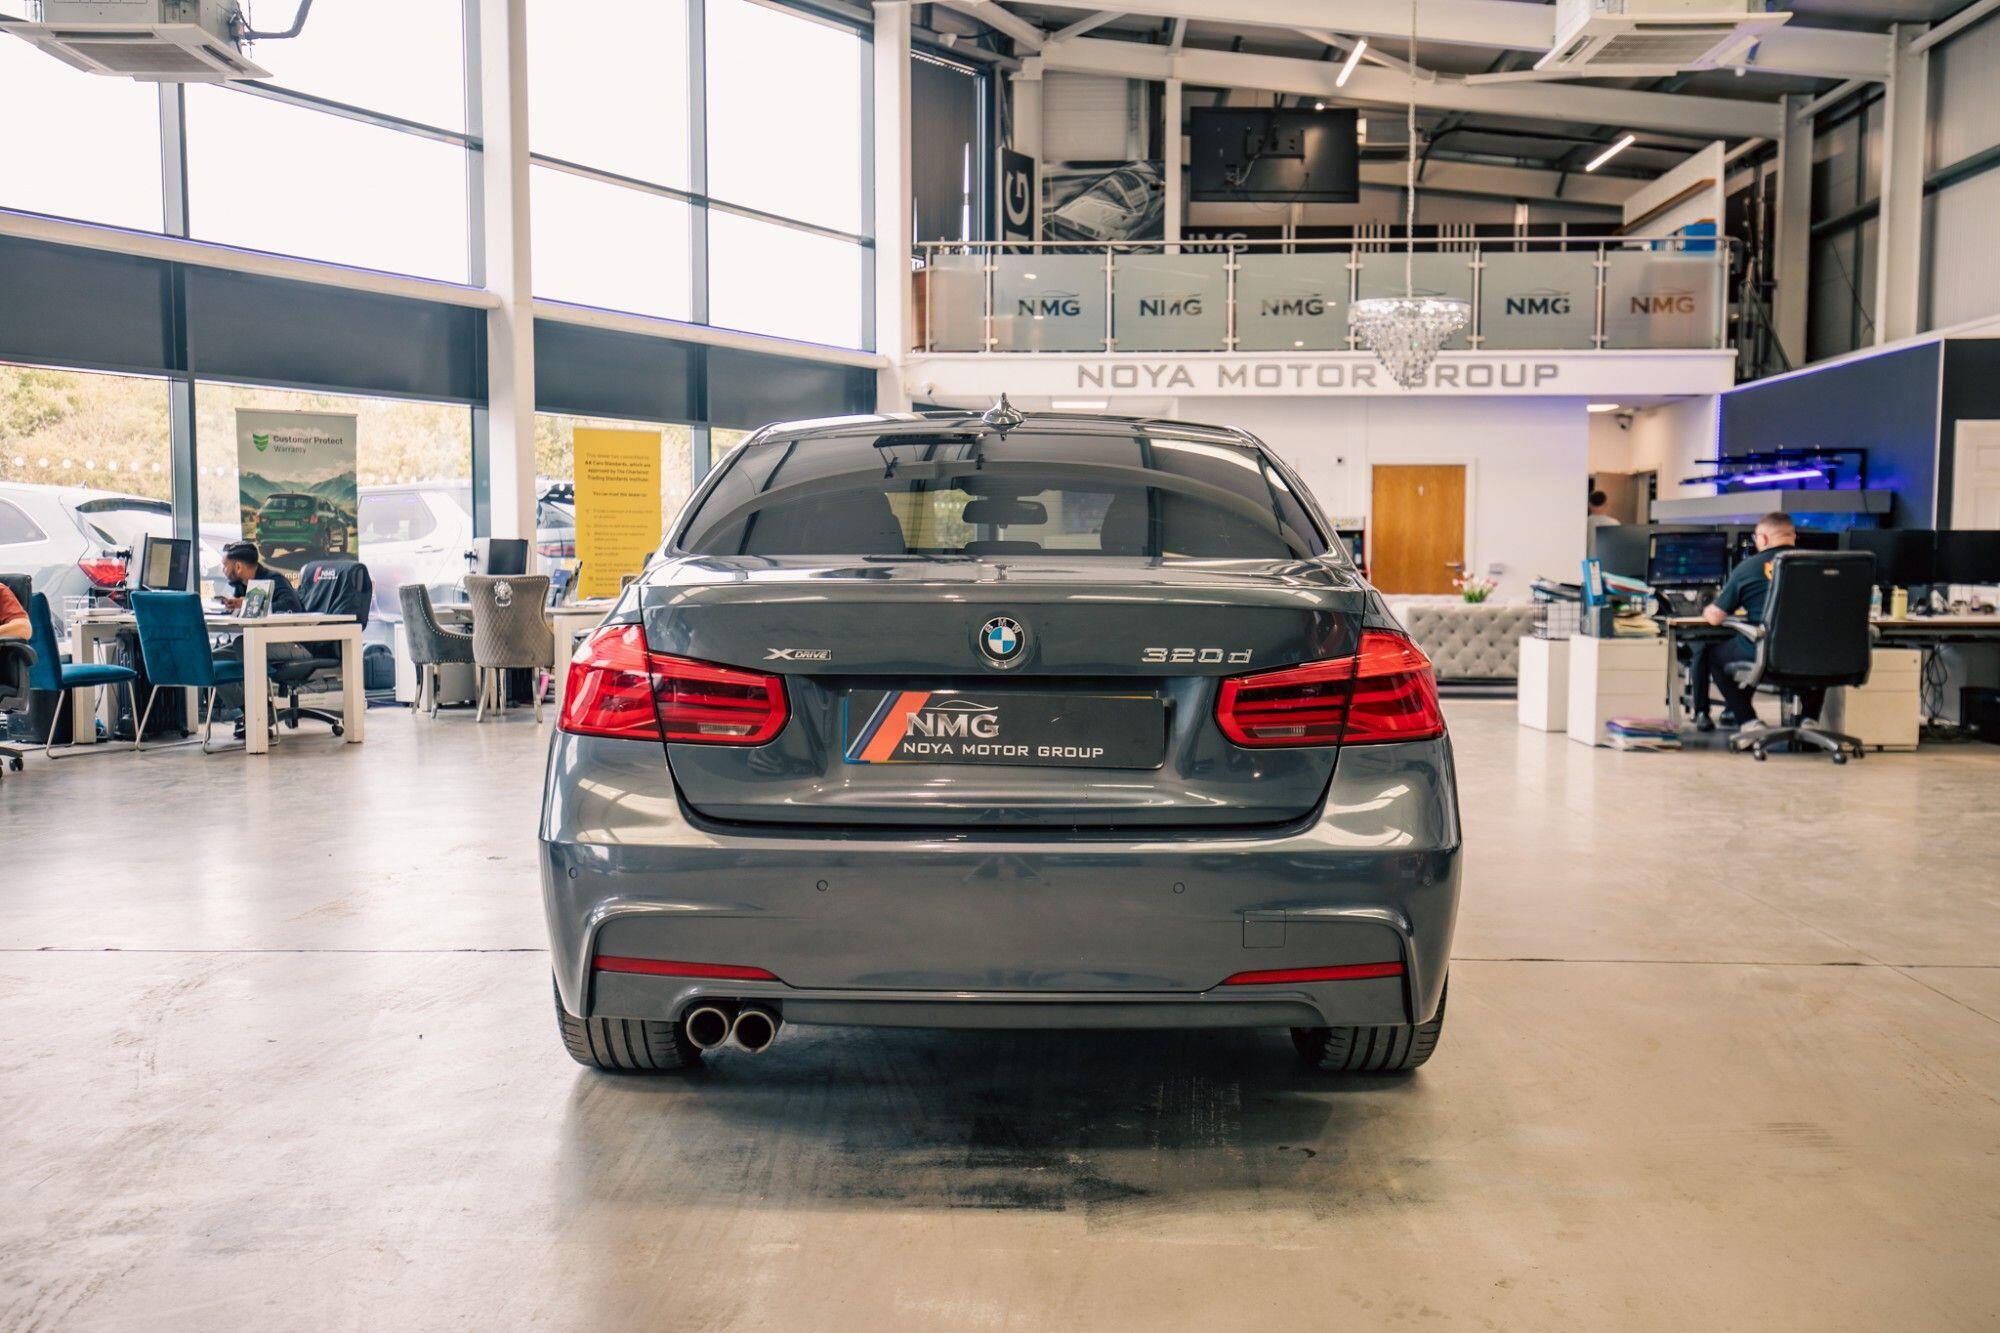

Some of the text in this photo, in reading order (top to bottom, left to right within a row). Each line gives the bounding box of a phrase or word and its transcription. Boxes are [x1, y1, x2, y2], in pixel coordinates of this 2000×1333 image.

[1018, 299, 1081, 317] NMG
[1261, 299, 1325, 317] NMG
[1505, 297, 1571, 315] NMG
[1630, 296, 1696, 314] NMG
[1077, 364, 1196, 388] NOYA
[1217, 364, 1378, 388] MOTOR
[273, 435, 343, 446] Customer Protect
[273, 445, 307, 455] Warranty
[1141, 647, 1253, 664] 320d
[905, 711, 1000, 739] NMG
[903, 742, 1104, 759] NOYA MOTOR GROUP
